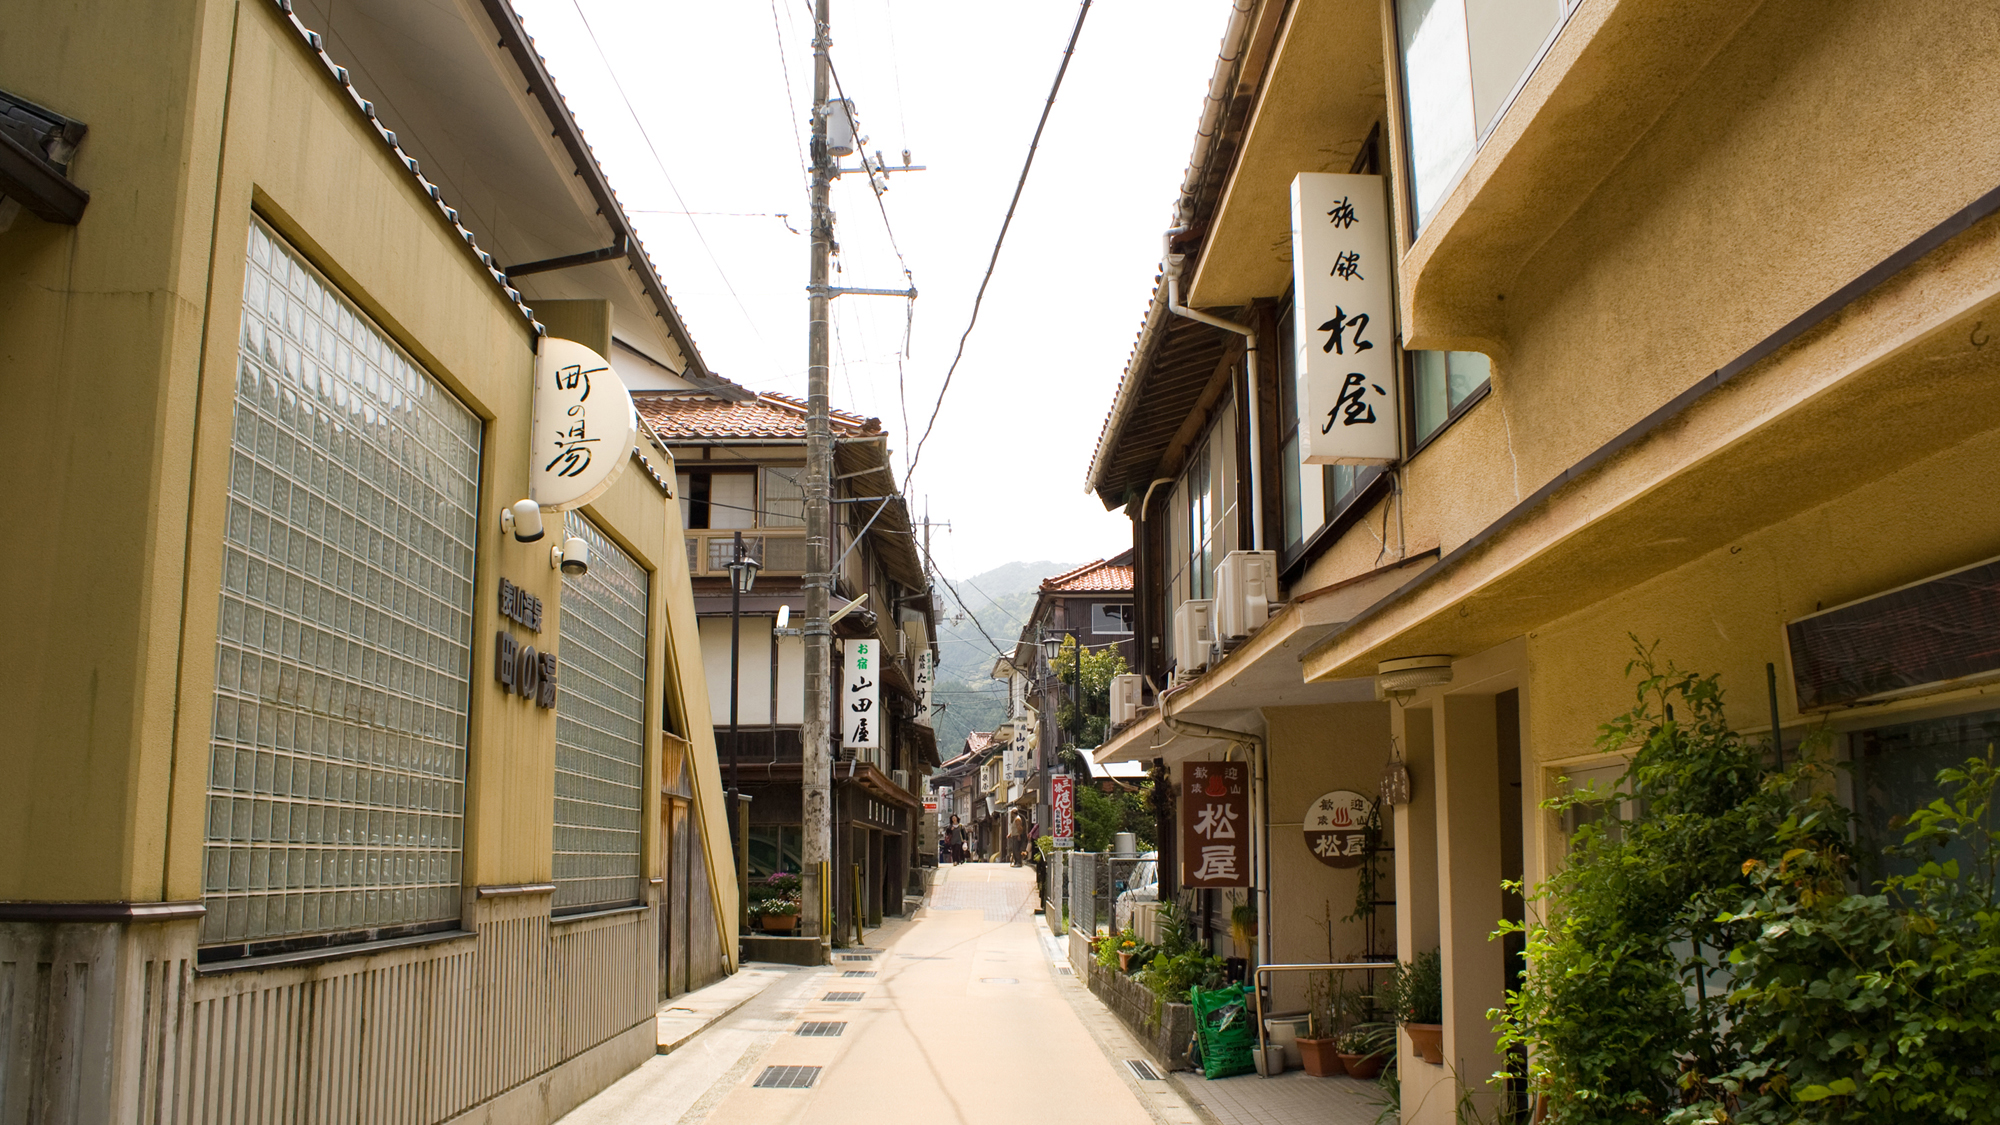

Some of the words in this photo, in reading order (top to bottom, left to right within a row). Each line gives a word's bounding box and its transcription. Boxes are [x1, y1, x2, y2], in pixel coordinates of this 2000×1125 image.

[1317, 305, 1386, 435] 松屋
[545, 364, 609, 478] 町の湯
[498, 577, 543, 634] 俵山温泉
[494, 630, 558, 710] 町の湯
[856, 643, 869, 670] お宿
[851, 675, 873, 743] 山田屋
[1015, 732, 1027, 768] 山口屋
[1192, 802, 1240, 881] 松屋
[1313, 834, 1366, 858] 松屋
